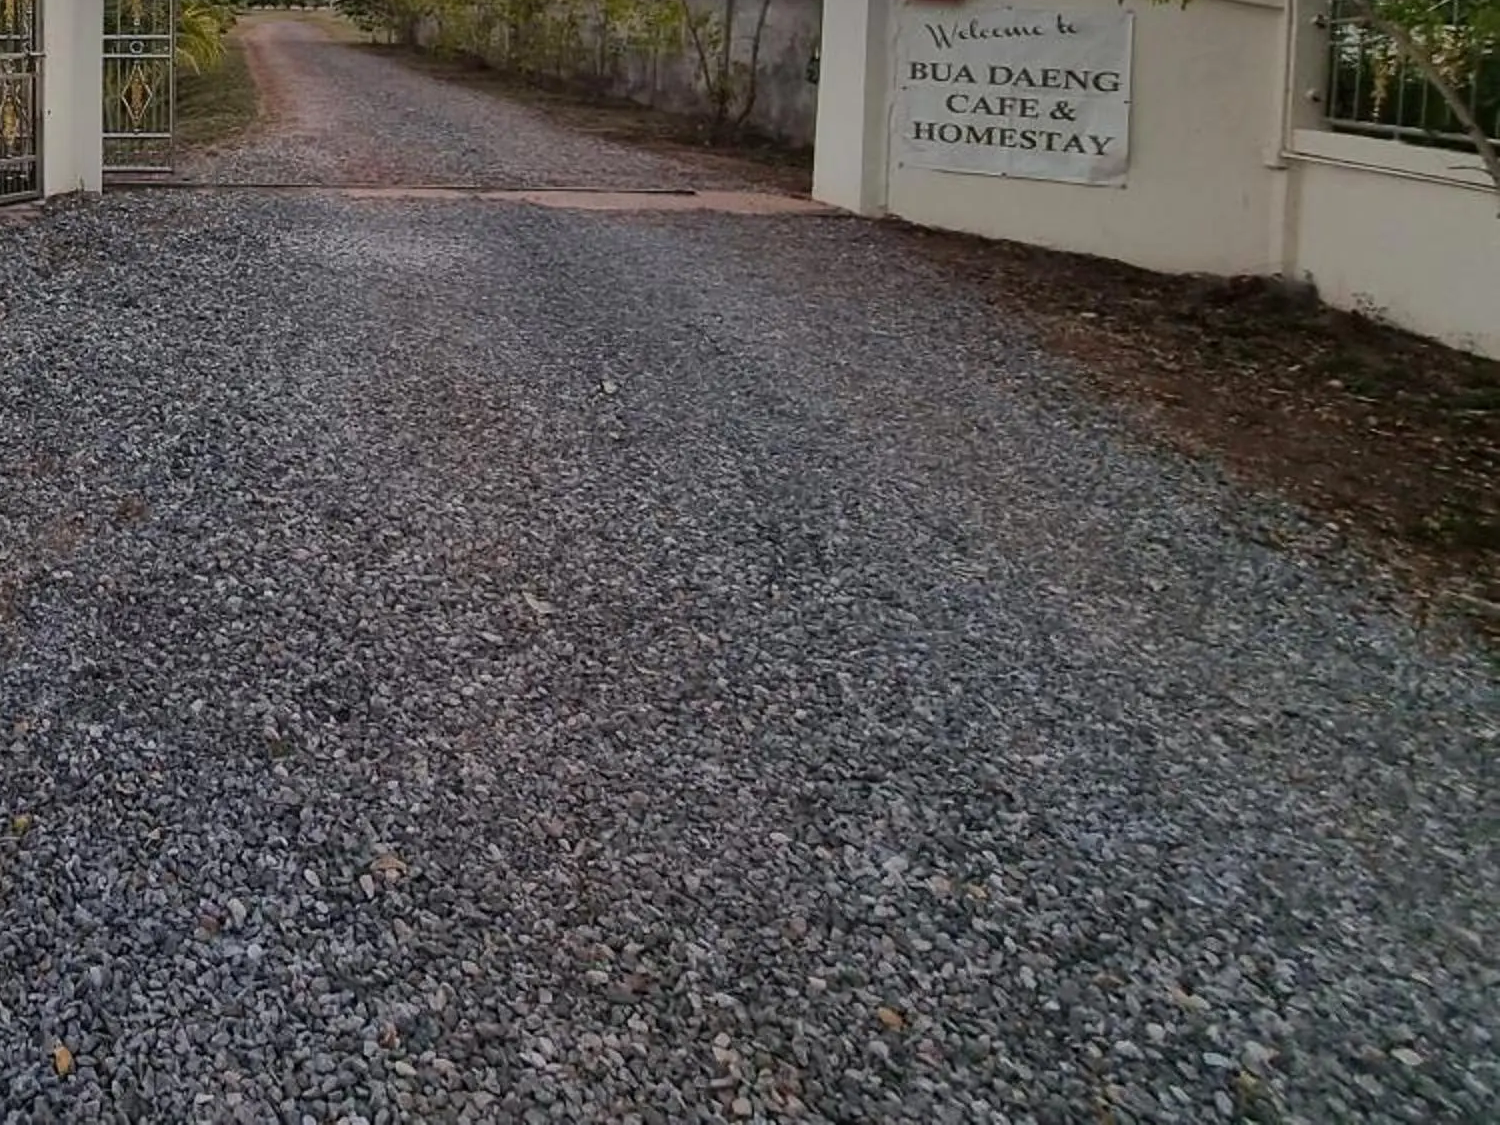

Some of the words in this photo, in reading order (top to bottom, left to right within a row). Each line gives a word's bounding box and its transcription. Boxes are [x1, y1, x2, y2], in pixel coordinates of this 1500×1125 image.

[924, 18, 1044, 49] Welcome
[1056, 13, 1078, 34] to
[909, 61, 977, 84] BUA
[988, 65, 1121, 91] DAENG
[945, 94, 1039, 119] CAFE
[1049, 100, 1077, 122] &
[912, 121, 1115, 156] HOMESTAY
